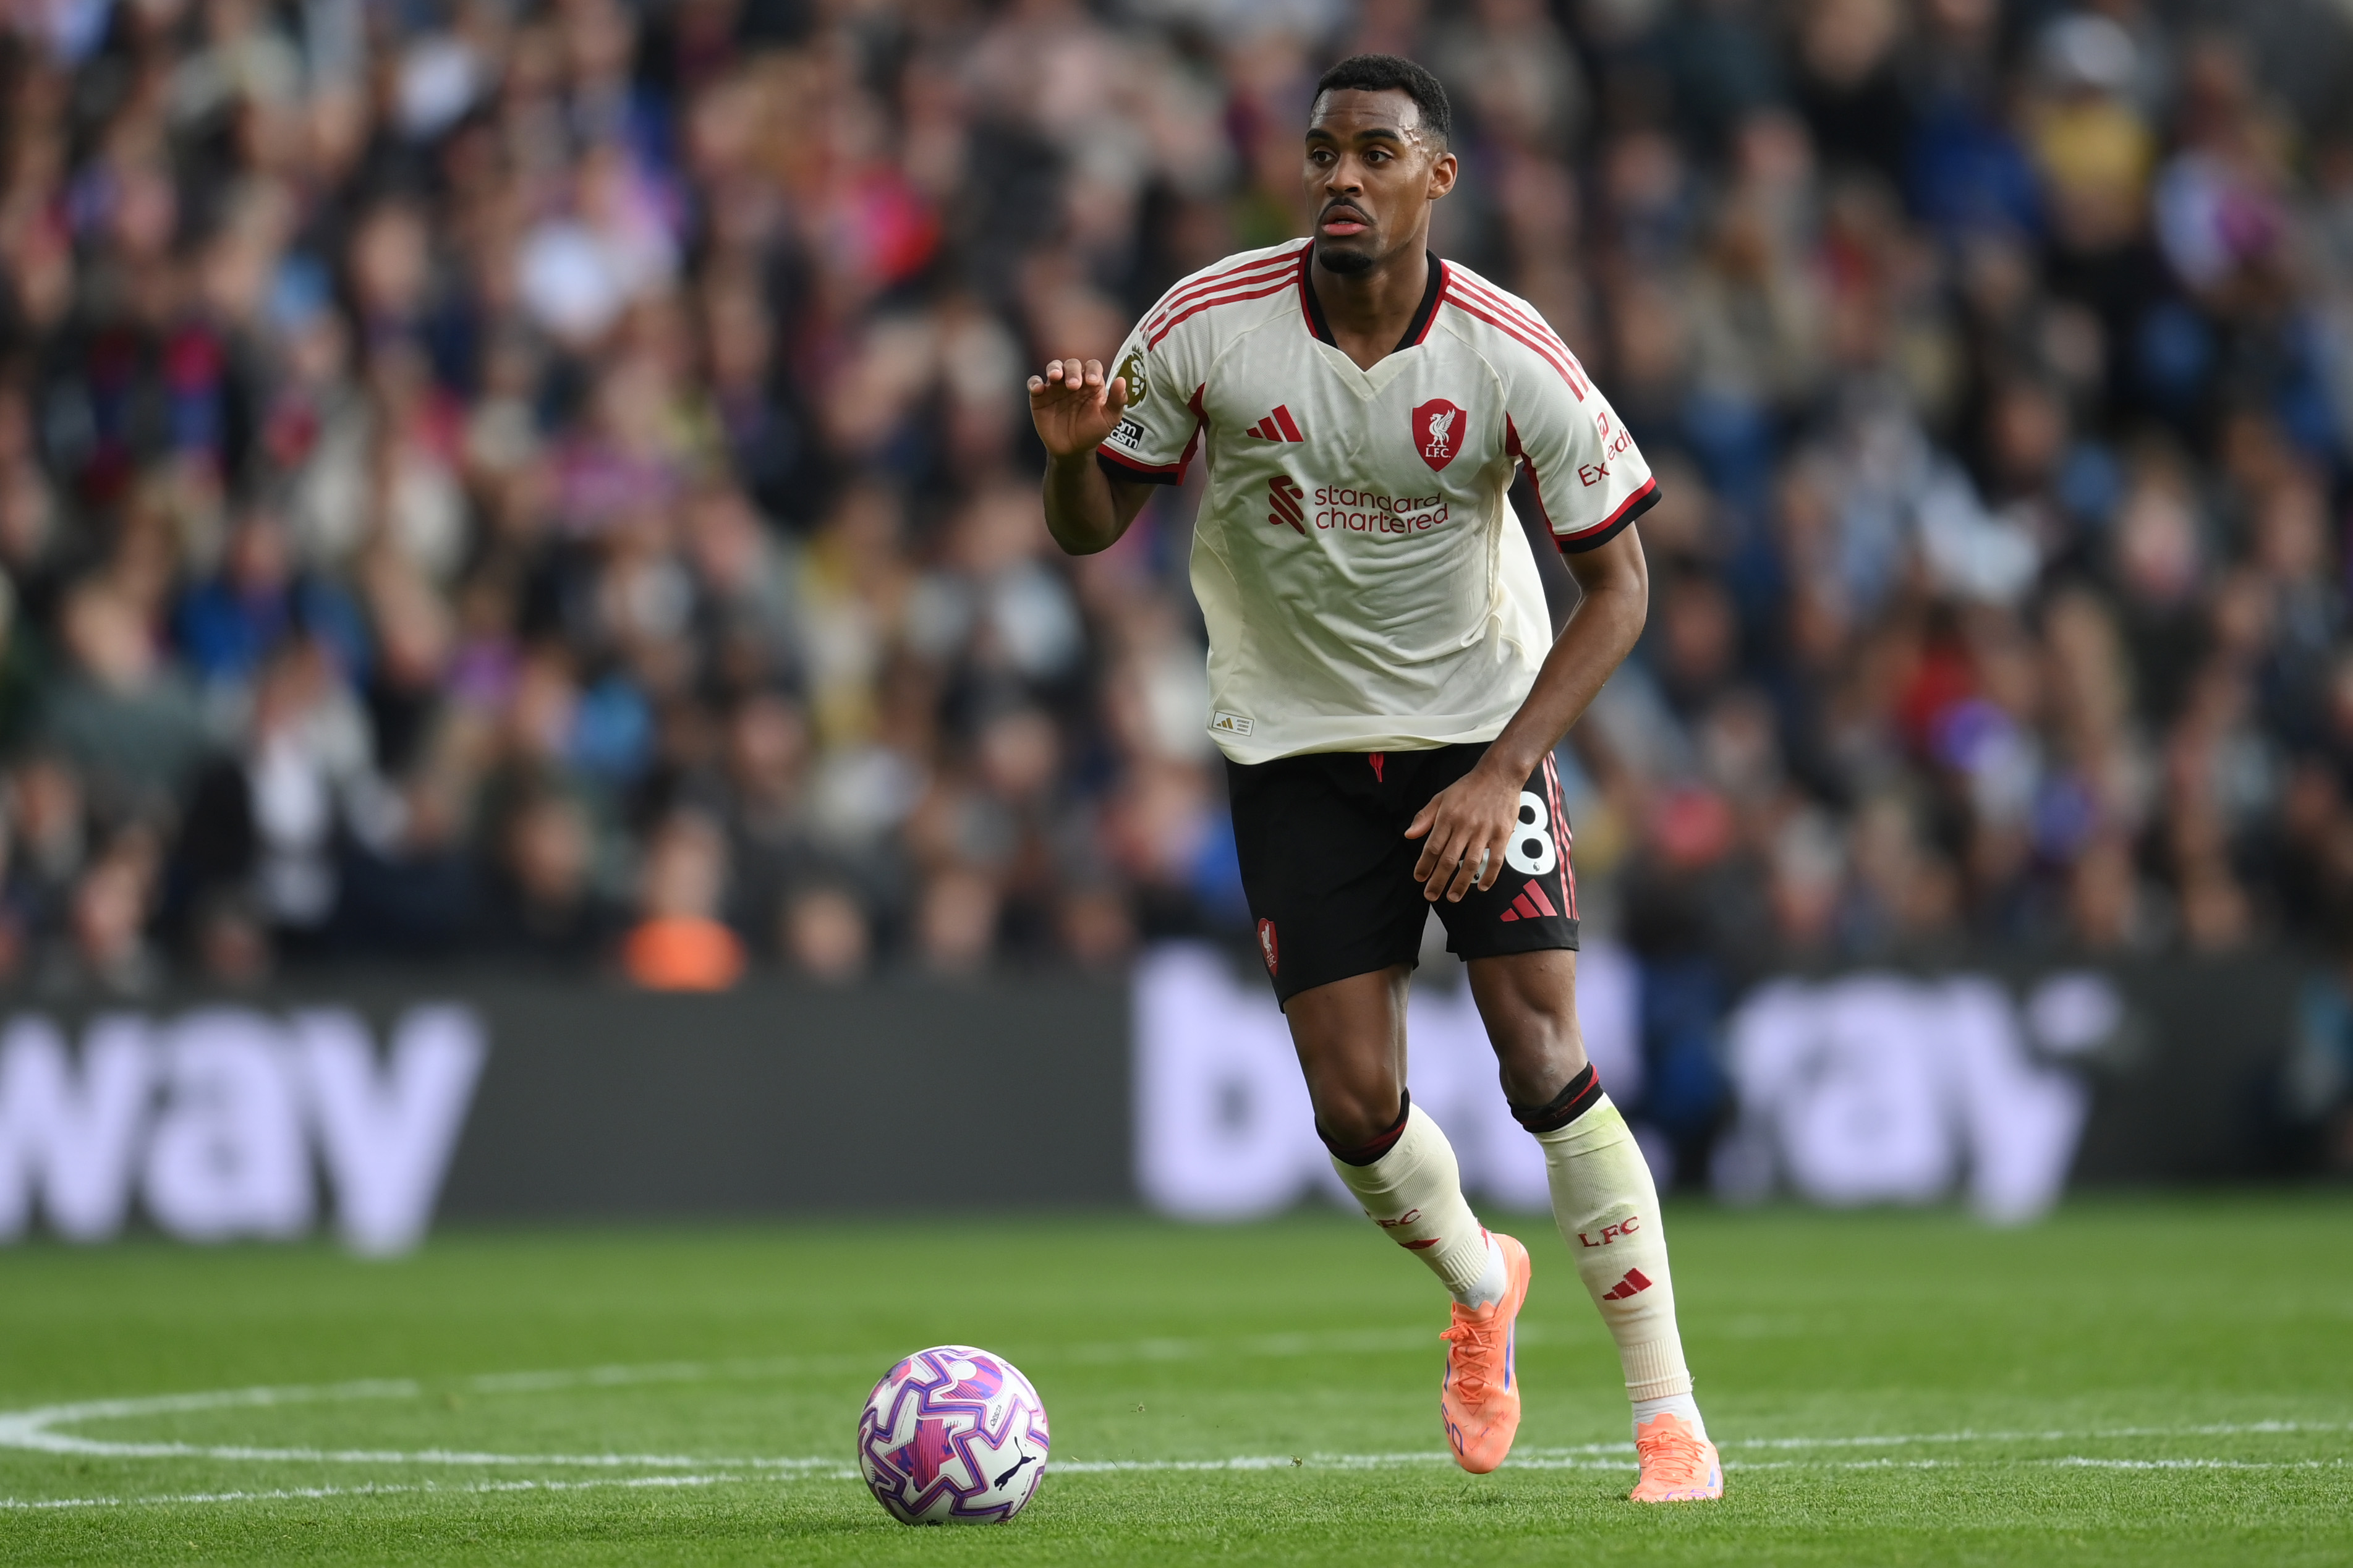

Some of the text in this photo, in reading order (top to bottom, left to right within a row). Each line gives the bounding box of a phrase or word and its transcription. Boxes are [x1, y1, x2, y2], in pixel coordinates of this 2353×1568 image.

[1110, 429, 1138, 449] cism
[1578, 426, 1632, 487] Exedi
[1314, 485, 1441, 514] standard
[1316, 502, 1449, 533] chartered
[1578, 1216, 1640, 1247] LFC
